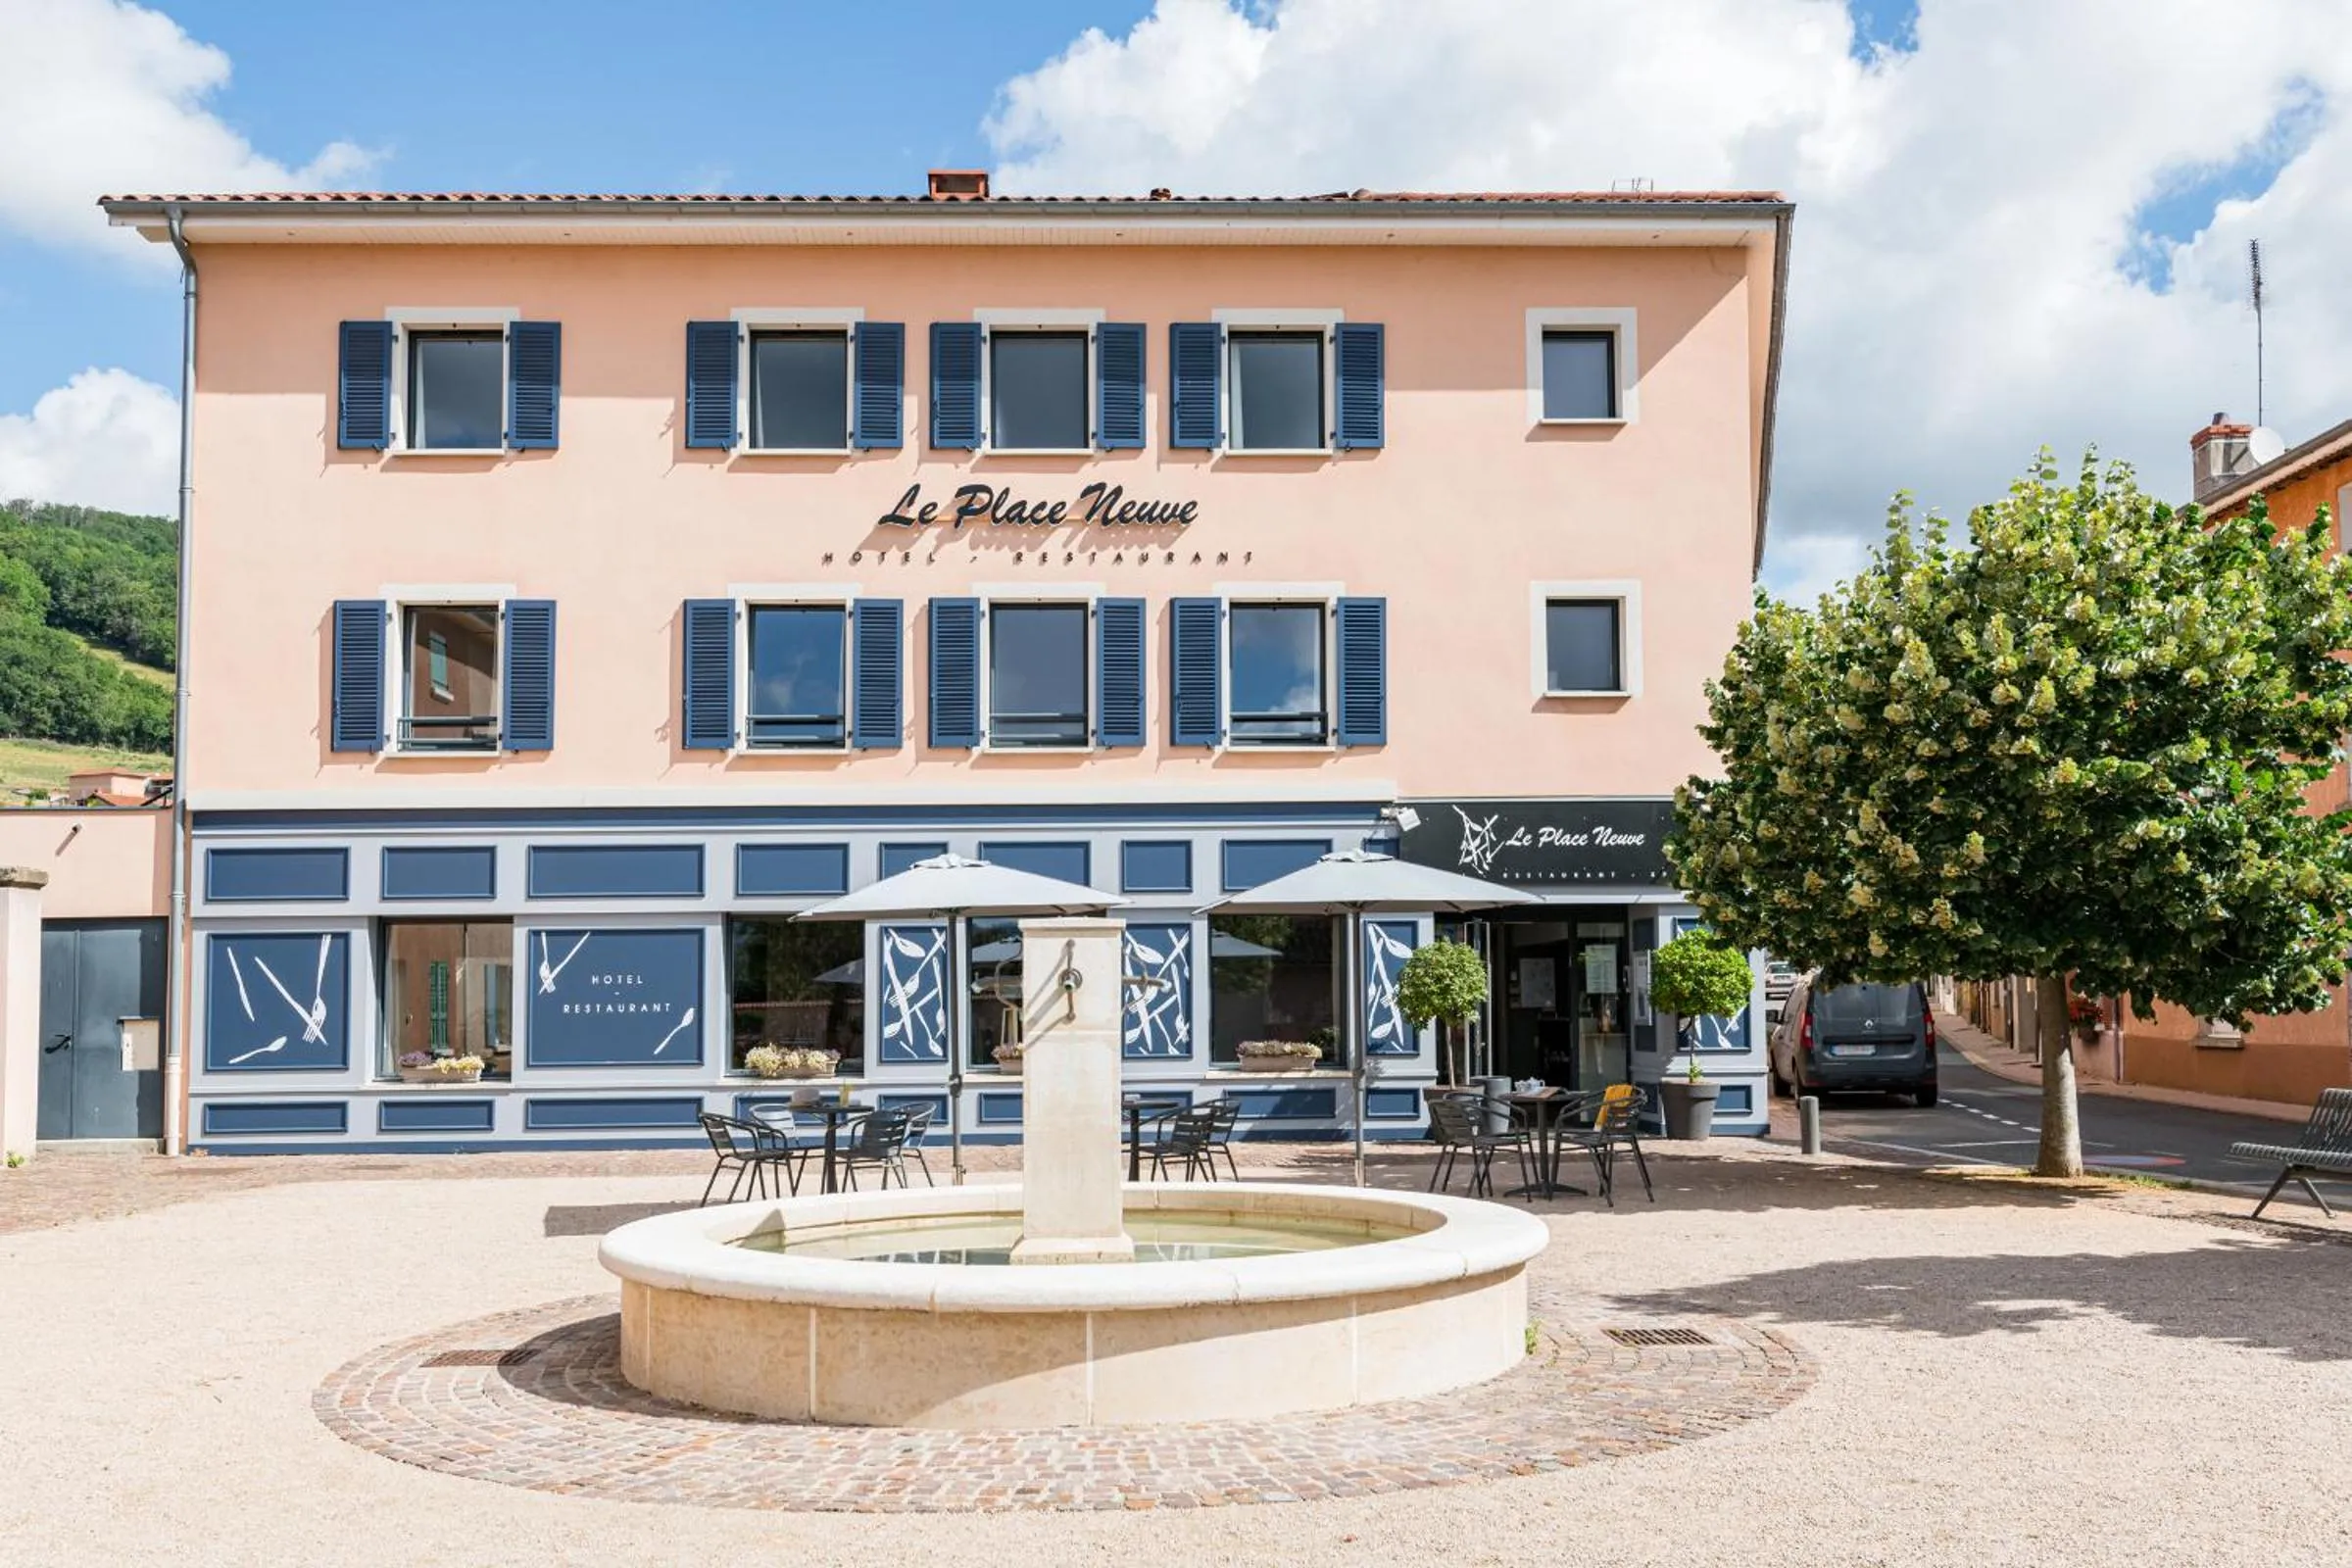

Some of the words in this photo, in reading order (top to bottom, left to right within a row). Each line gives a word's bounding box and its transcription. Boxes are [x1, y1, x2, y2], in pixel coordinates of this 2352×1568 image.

[878, 482, 938, 526] Le
[955, 484, 1067, 528] Place
[1079, 482, 1199, 527] Neuve
[824, 551, 935, 563] HOTEL
[1015, 552, 1252, 564] RESTAURANT
[1505, 826, 1532, 846] Le
[1538, 826, 1589, 848] Place
[1592, 826, 1645, 847] Neuve
[592, 975, 643, 984] HOTEL
[564, 1003, 671, 1013] RESTAURANT
